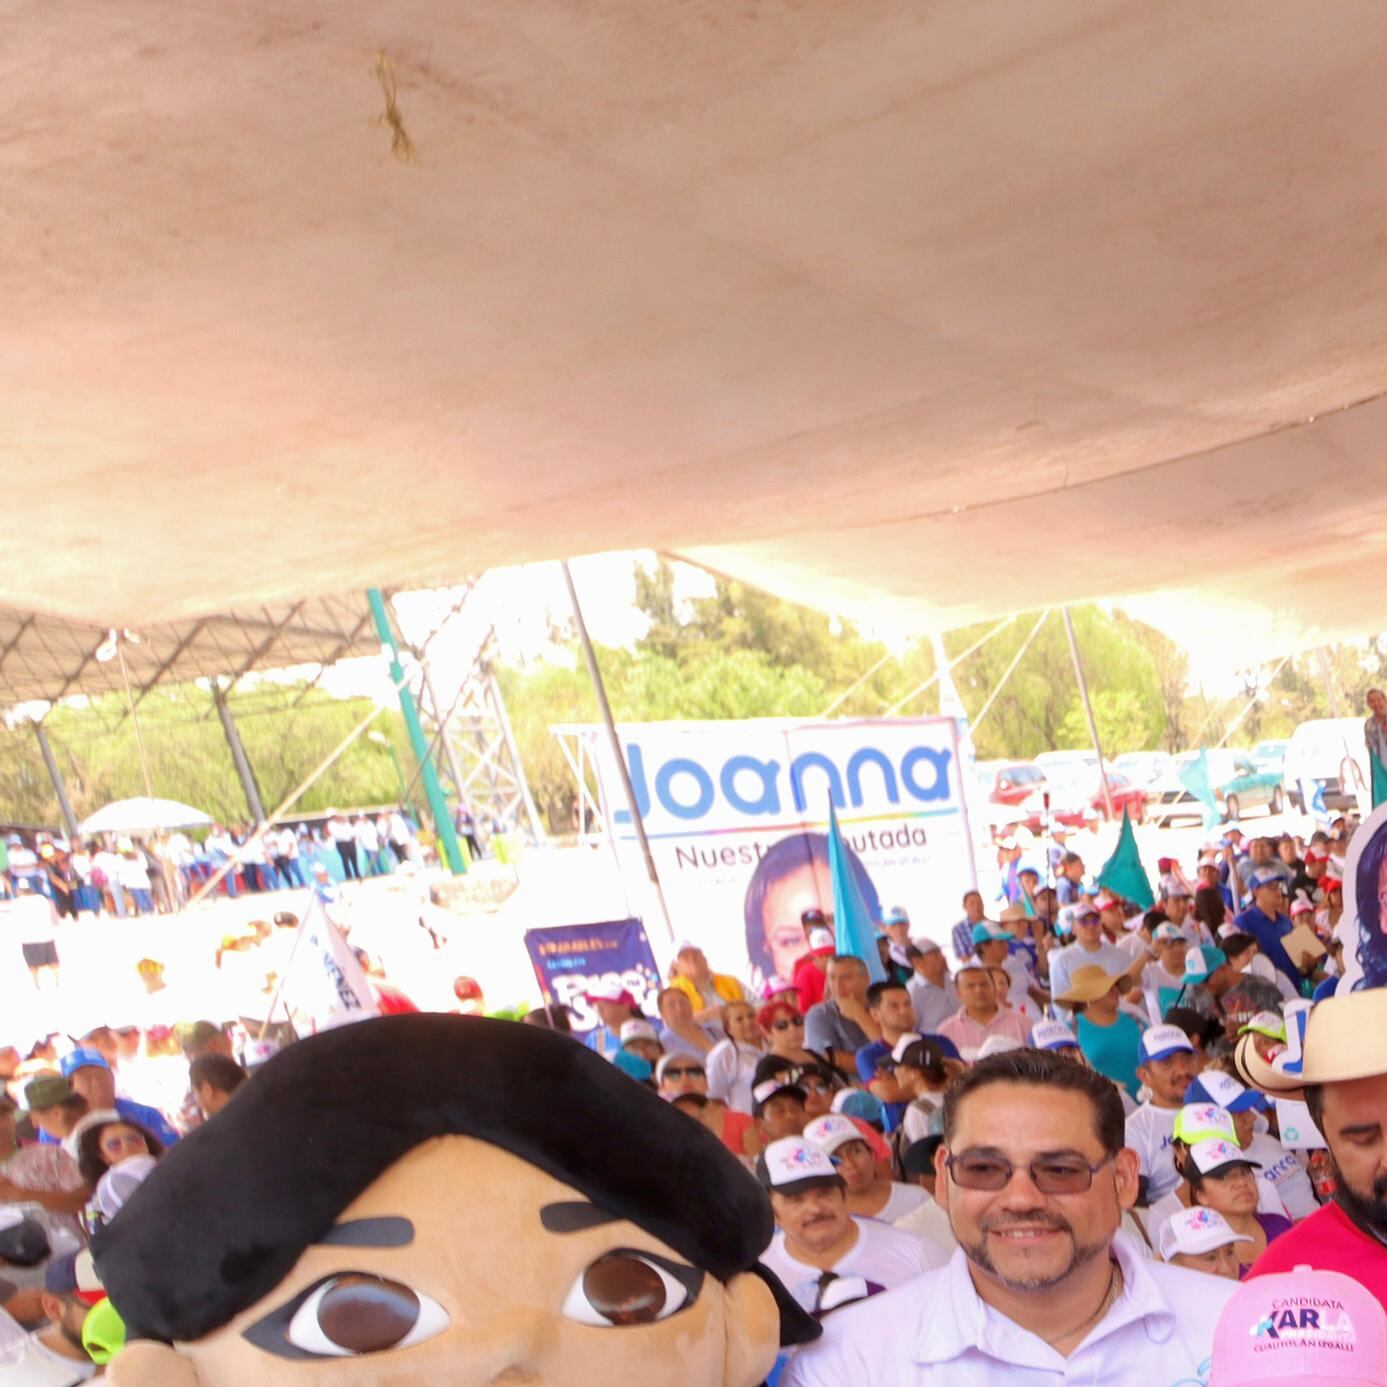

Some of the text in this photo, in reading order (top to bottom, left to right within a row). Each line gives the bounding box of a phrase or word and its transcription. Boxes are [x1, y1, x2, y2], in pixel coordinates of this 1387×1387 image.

[614, 743, 951, 823] Joanna
[1272, 1297, 1344, 1310] CANDIDATA
[1249, 1309, 1355, 1339] KARLA
